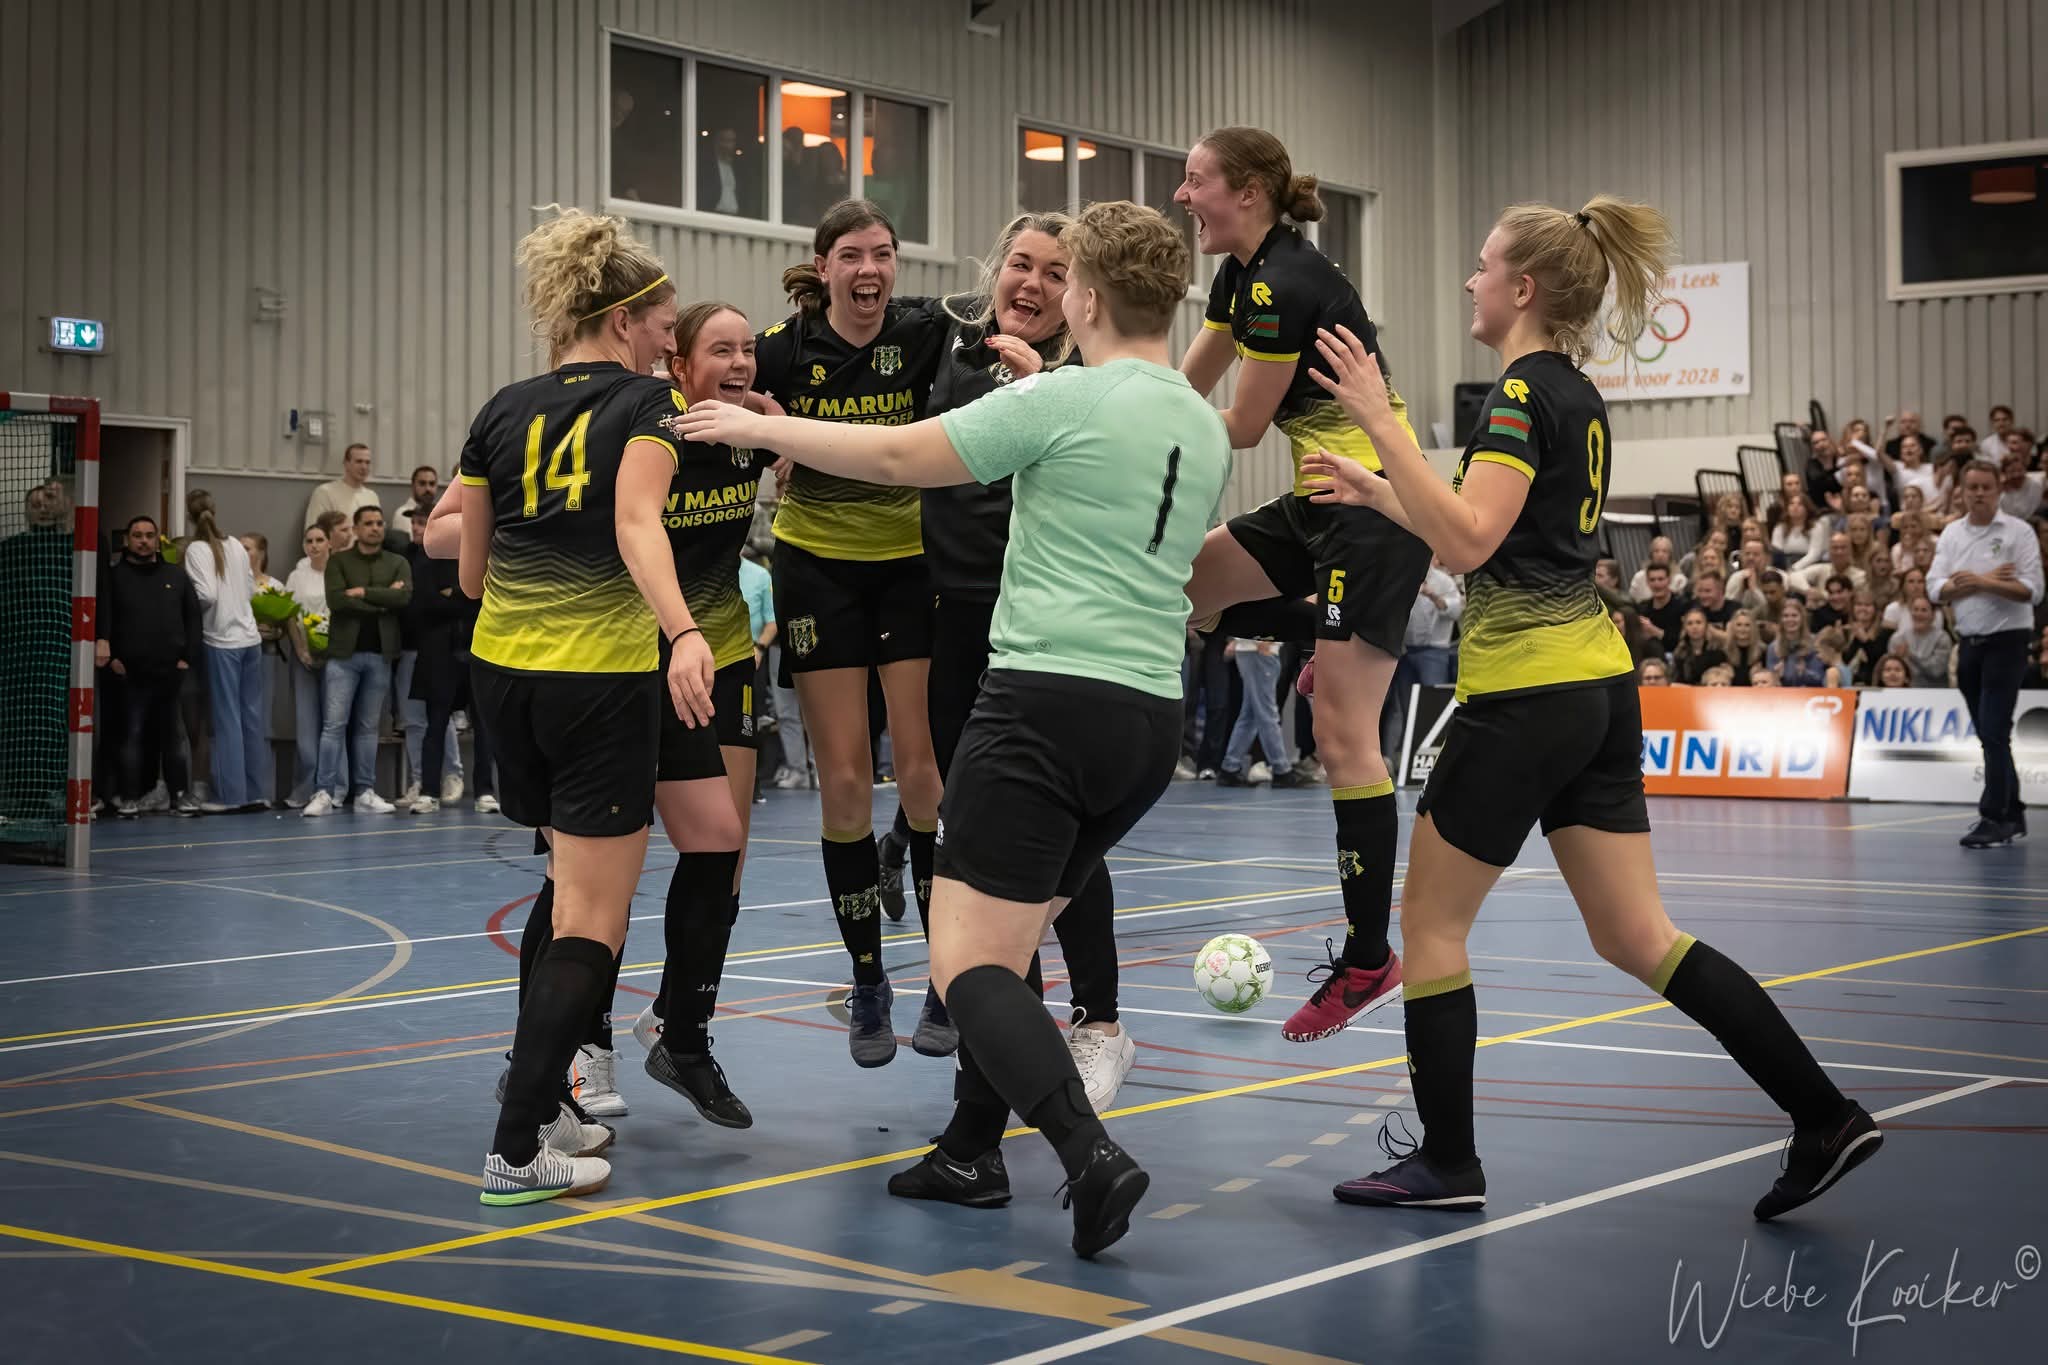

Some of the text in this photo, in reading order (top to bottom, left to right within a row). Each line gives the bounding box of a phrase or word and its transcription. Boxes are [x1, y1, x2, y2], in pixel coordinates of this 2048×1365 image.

[1682, 271, 1720, 289] Leek
[1677, 367, 1720, 385] 2028
[817, 389, 913, 417] MARUM
[522, 409, 593, 518] 14
[1579, 418, 1604, 534] 9
[1145, 444, 1182, 555] 1
[1327, 569, 1346, 603] 5
[1642, 736, 1819, 772] NNRD
